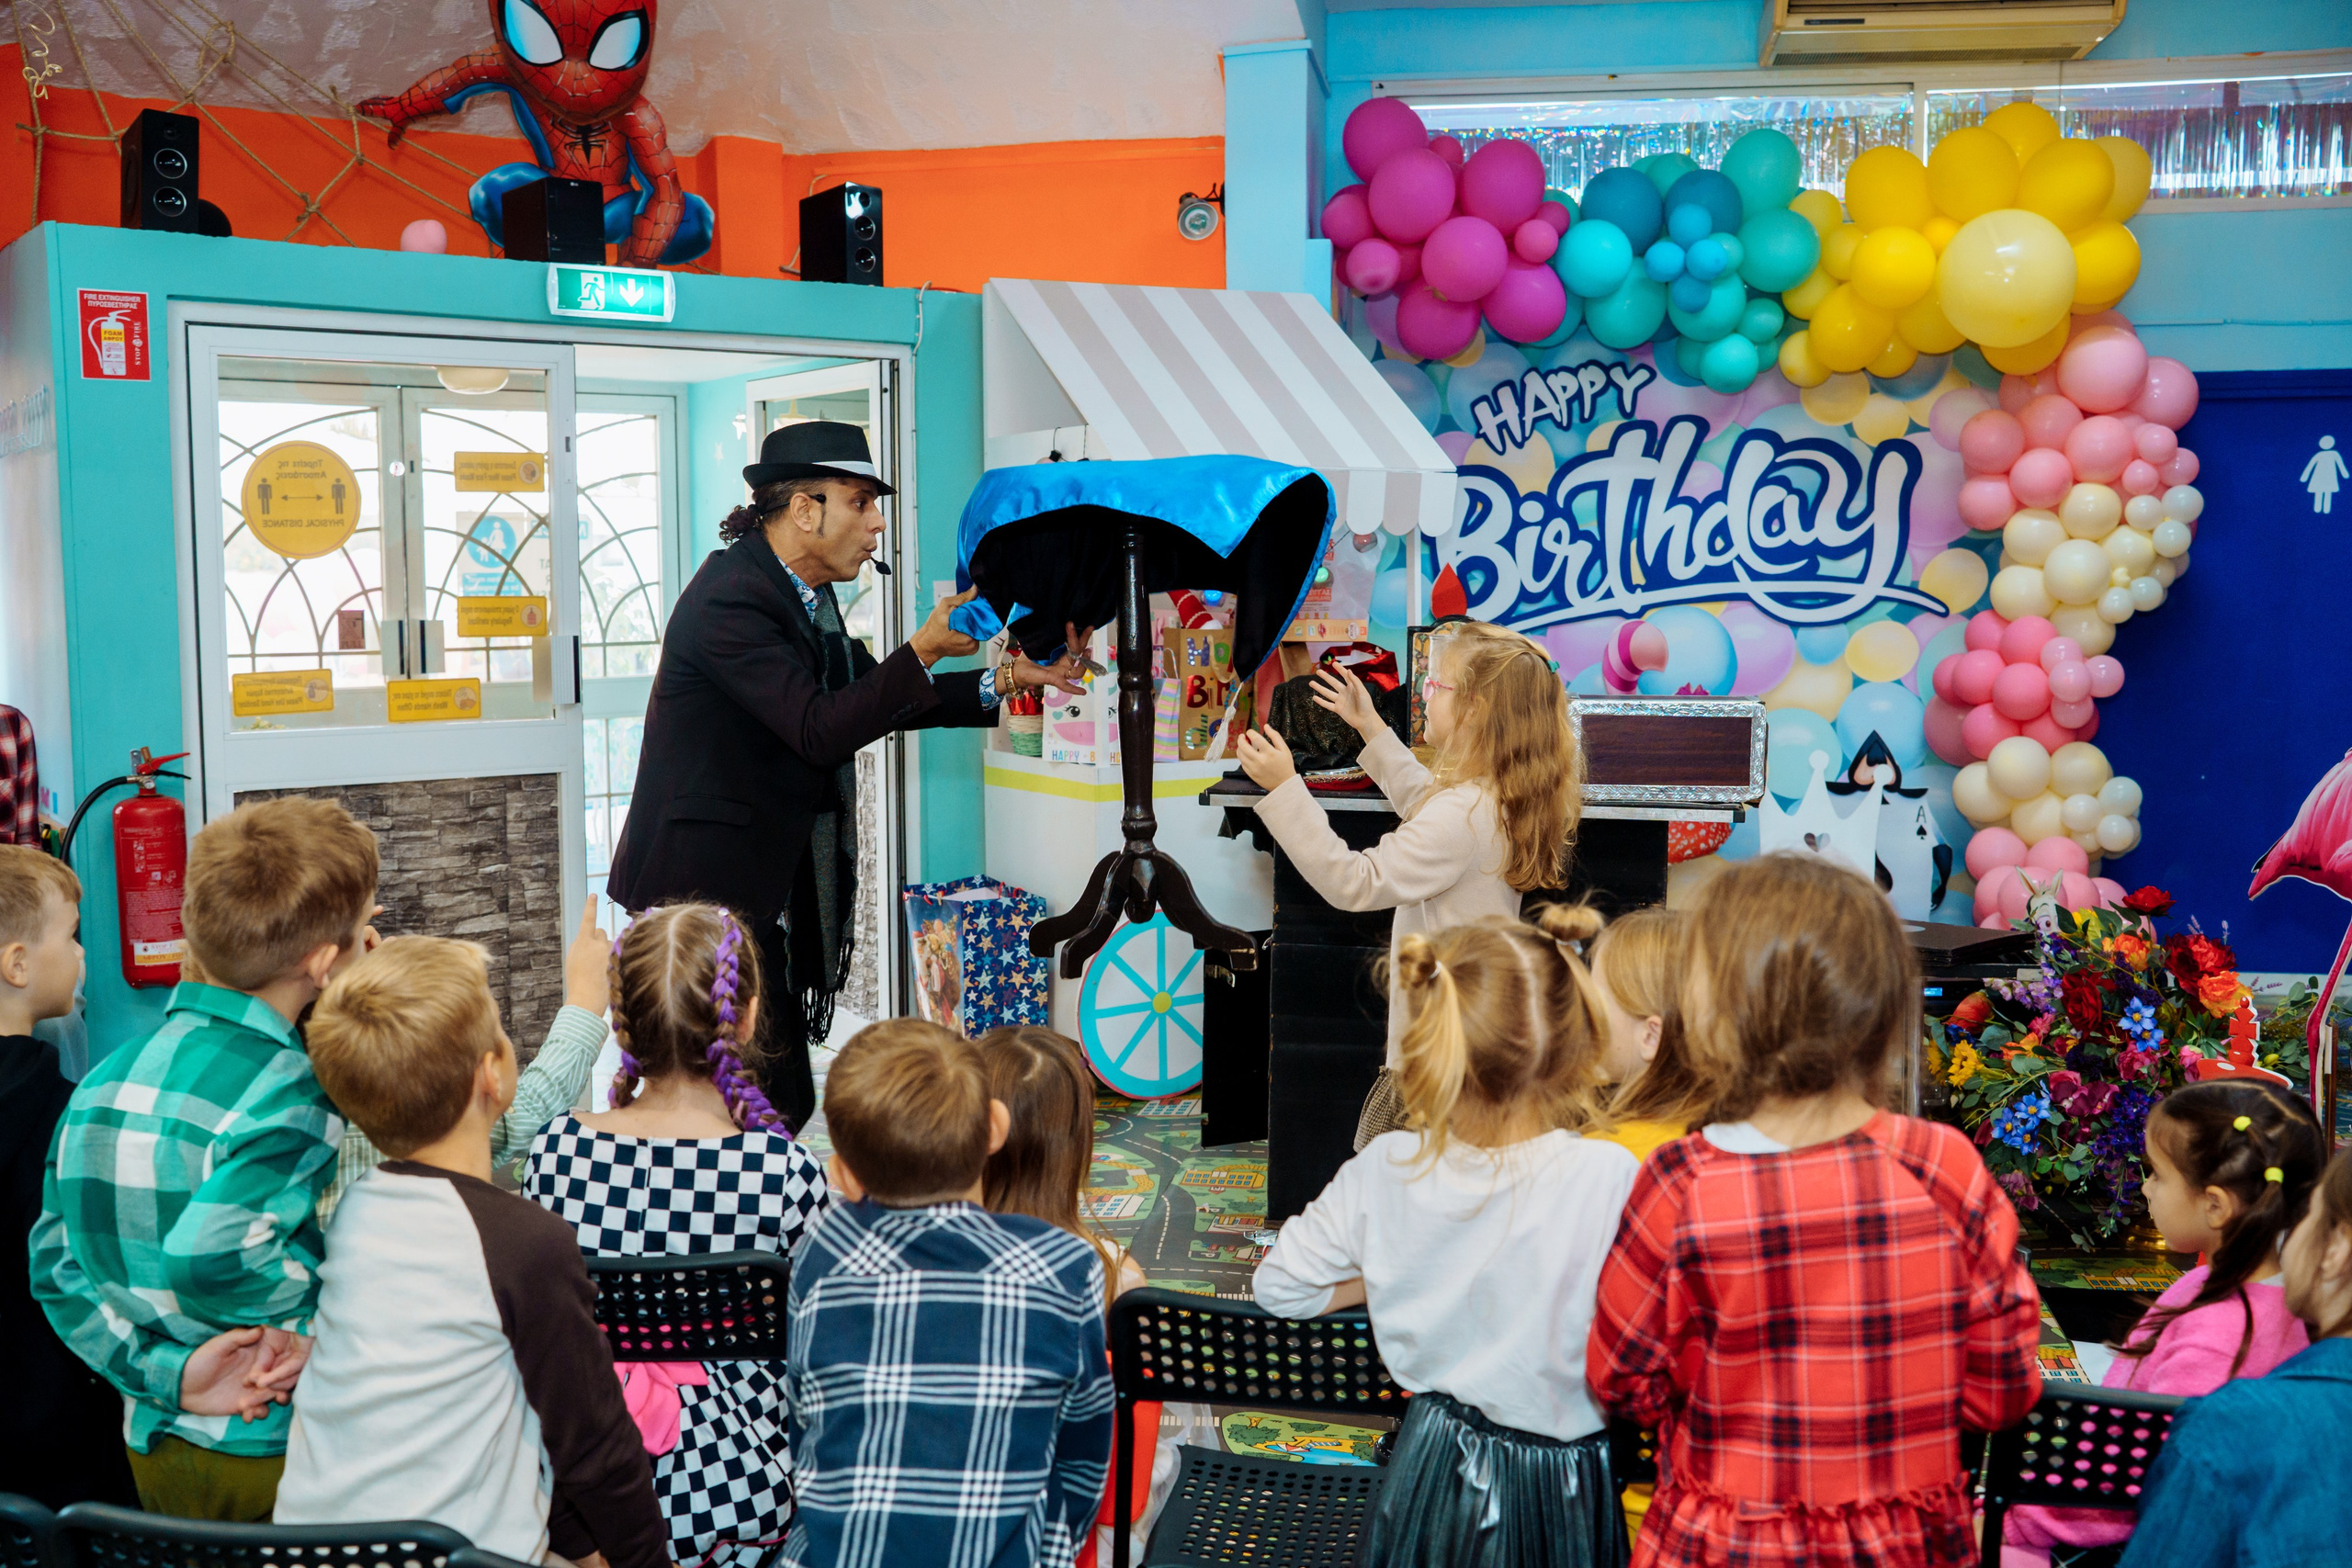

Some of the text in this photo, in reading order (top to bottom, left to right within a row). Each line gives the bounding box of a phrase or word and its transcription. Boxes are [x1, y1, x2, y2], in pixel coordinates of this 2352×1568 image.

[97, 294, 141, 302] EXTINGUISHER
[87, 300, 138, 310] ΠΥΡΟΣΒΕΣΤΗΡΑΣ
[1471, 360, 1657, 455] HAPPY
[1052, 750, 1080, 761] HAPPY
[1916, 805, 1927, 824] A
